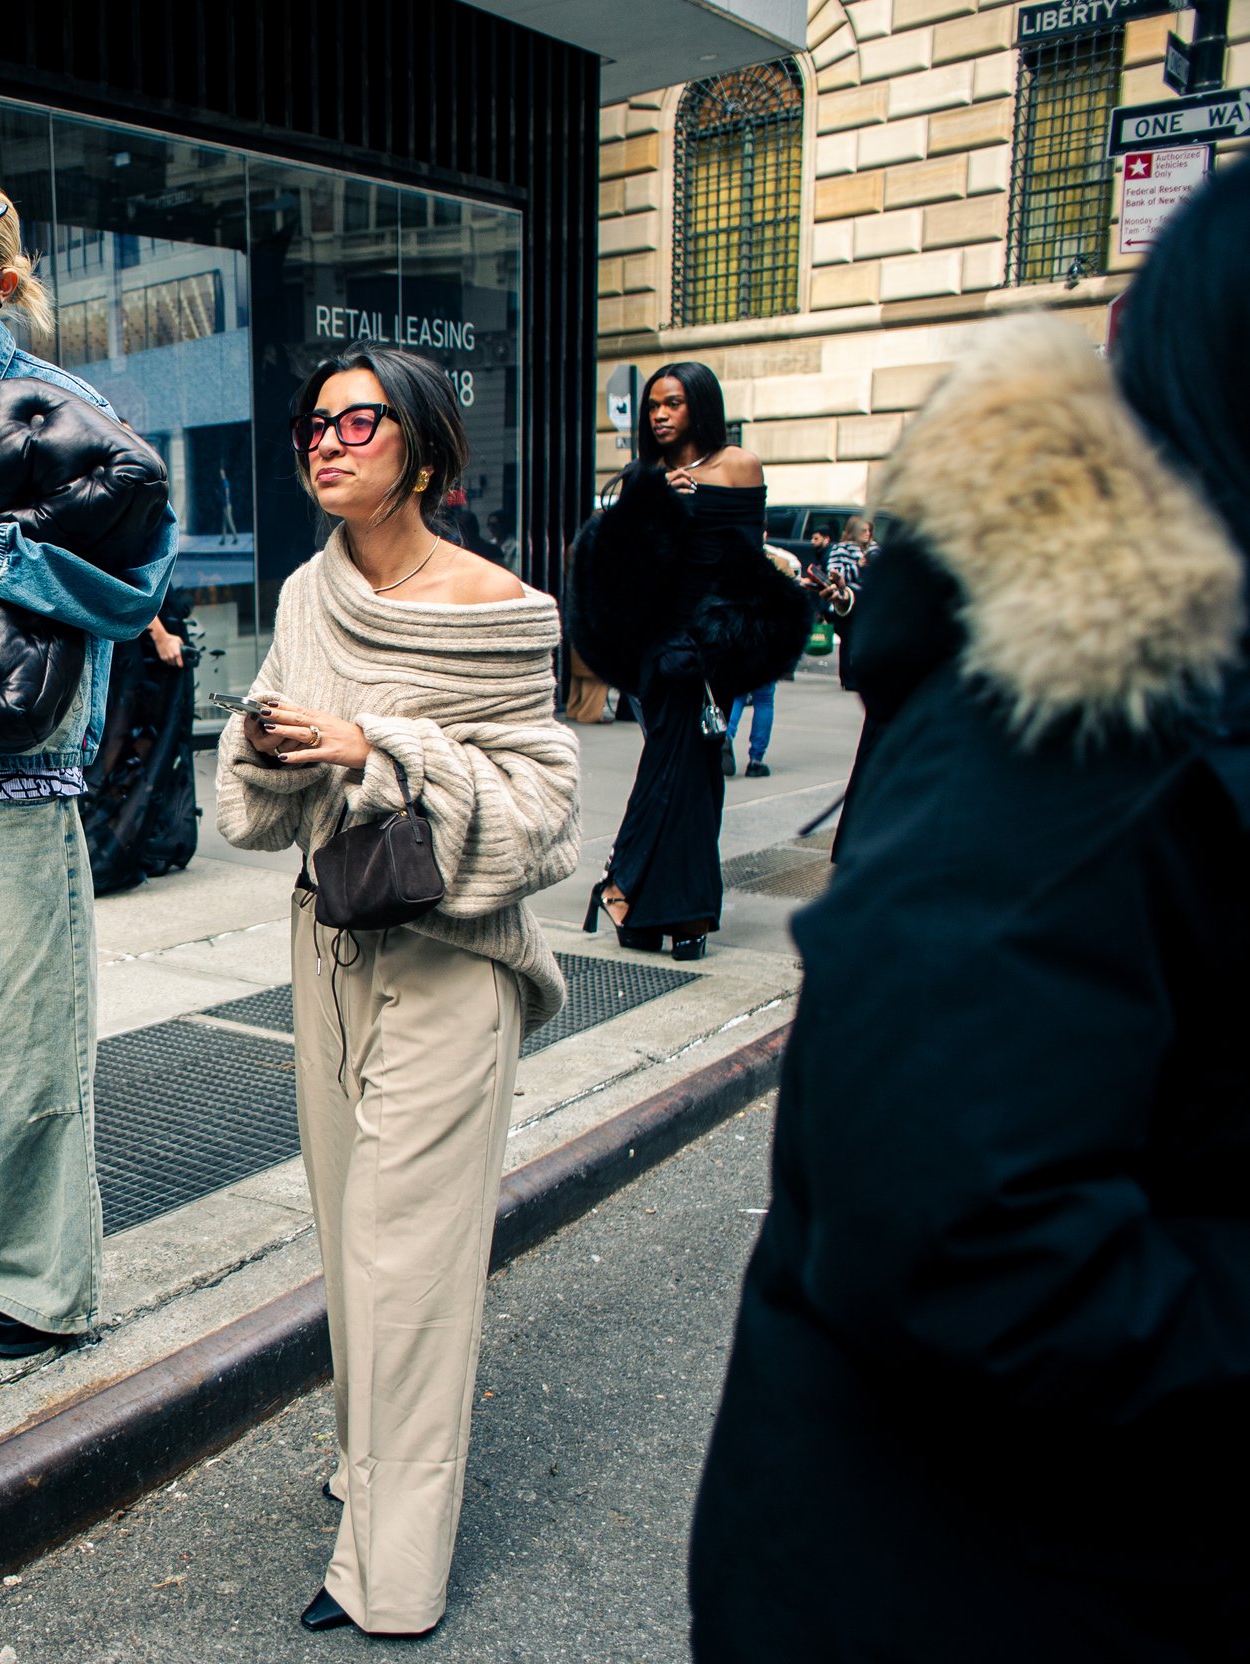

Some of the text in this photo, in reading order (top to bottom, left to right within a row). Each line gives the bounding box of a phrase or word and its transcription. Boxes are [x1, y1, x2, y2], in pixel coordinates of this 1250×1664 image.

[1022, 0, 1118, 35] LIBERTY
[1134, 103, 1250, 138] ONE WA
[1156, 152, 1201, 161] Authorized
[1155, 161, 1188, 169] Vehicles
[1126, 185, 1192, 196] Federal Reserve
[1125, 199, 1145, 207] Bank
[1148, 197, 1156, 206] of
[1158, 197, 1176, 205] New
[1124, 216, 1152, 225] Monday
[1124, 227, 1140, 235] 7am
[316, 305, 475, 351] RETAIL LEASING
